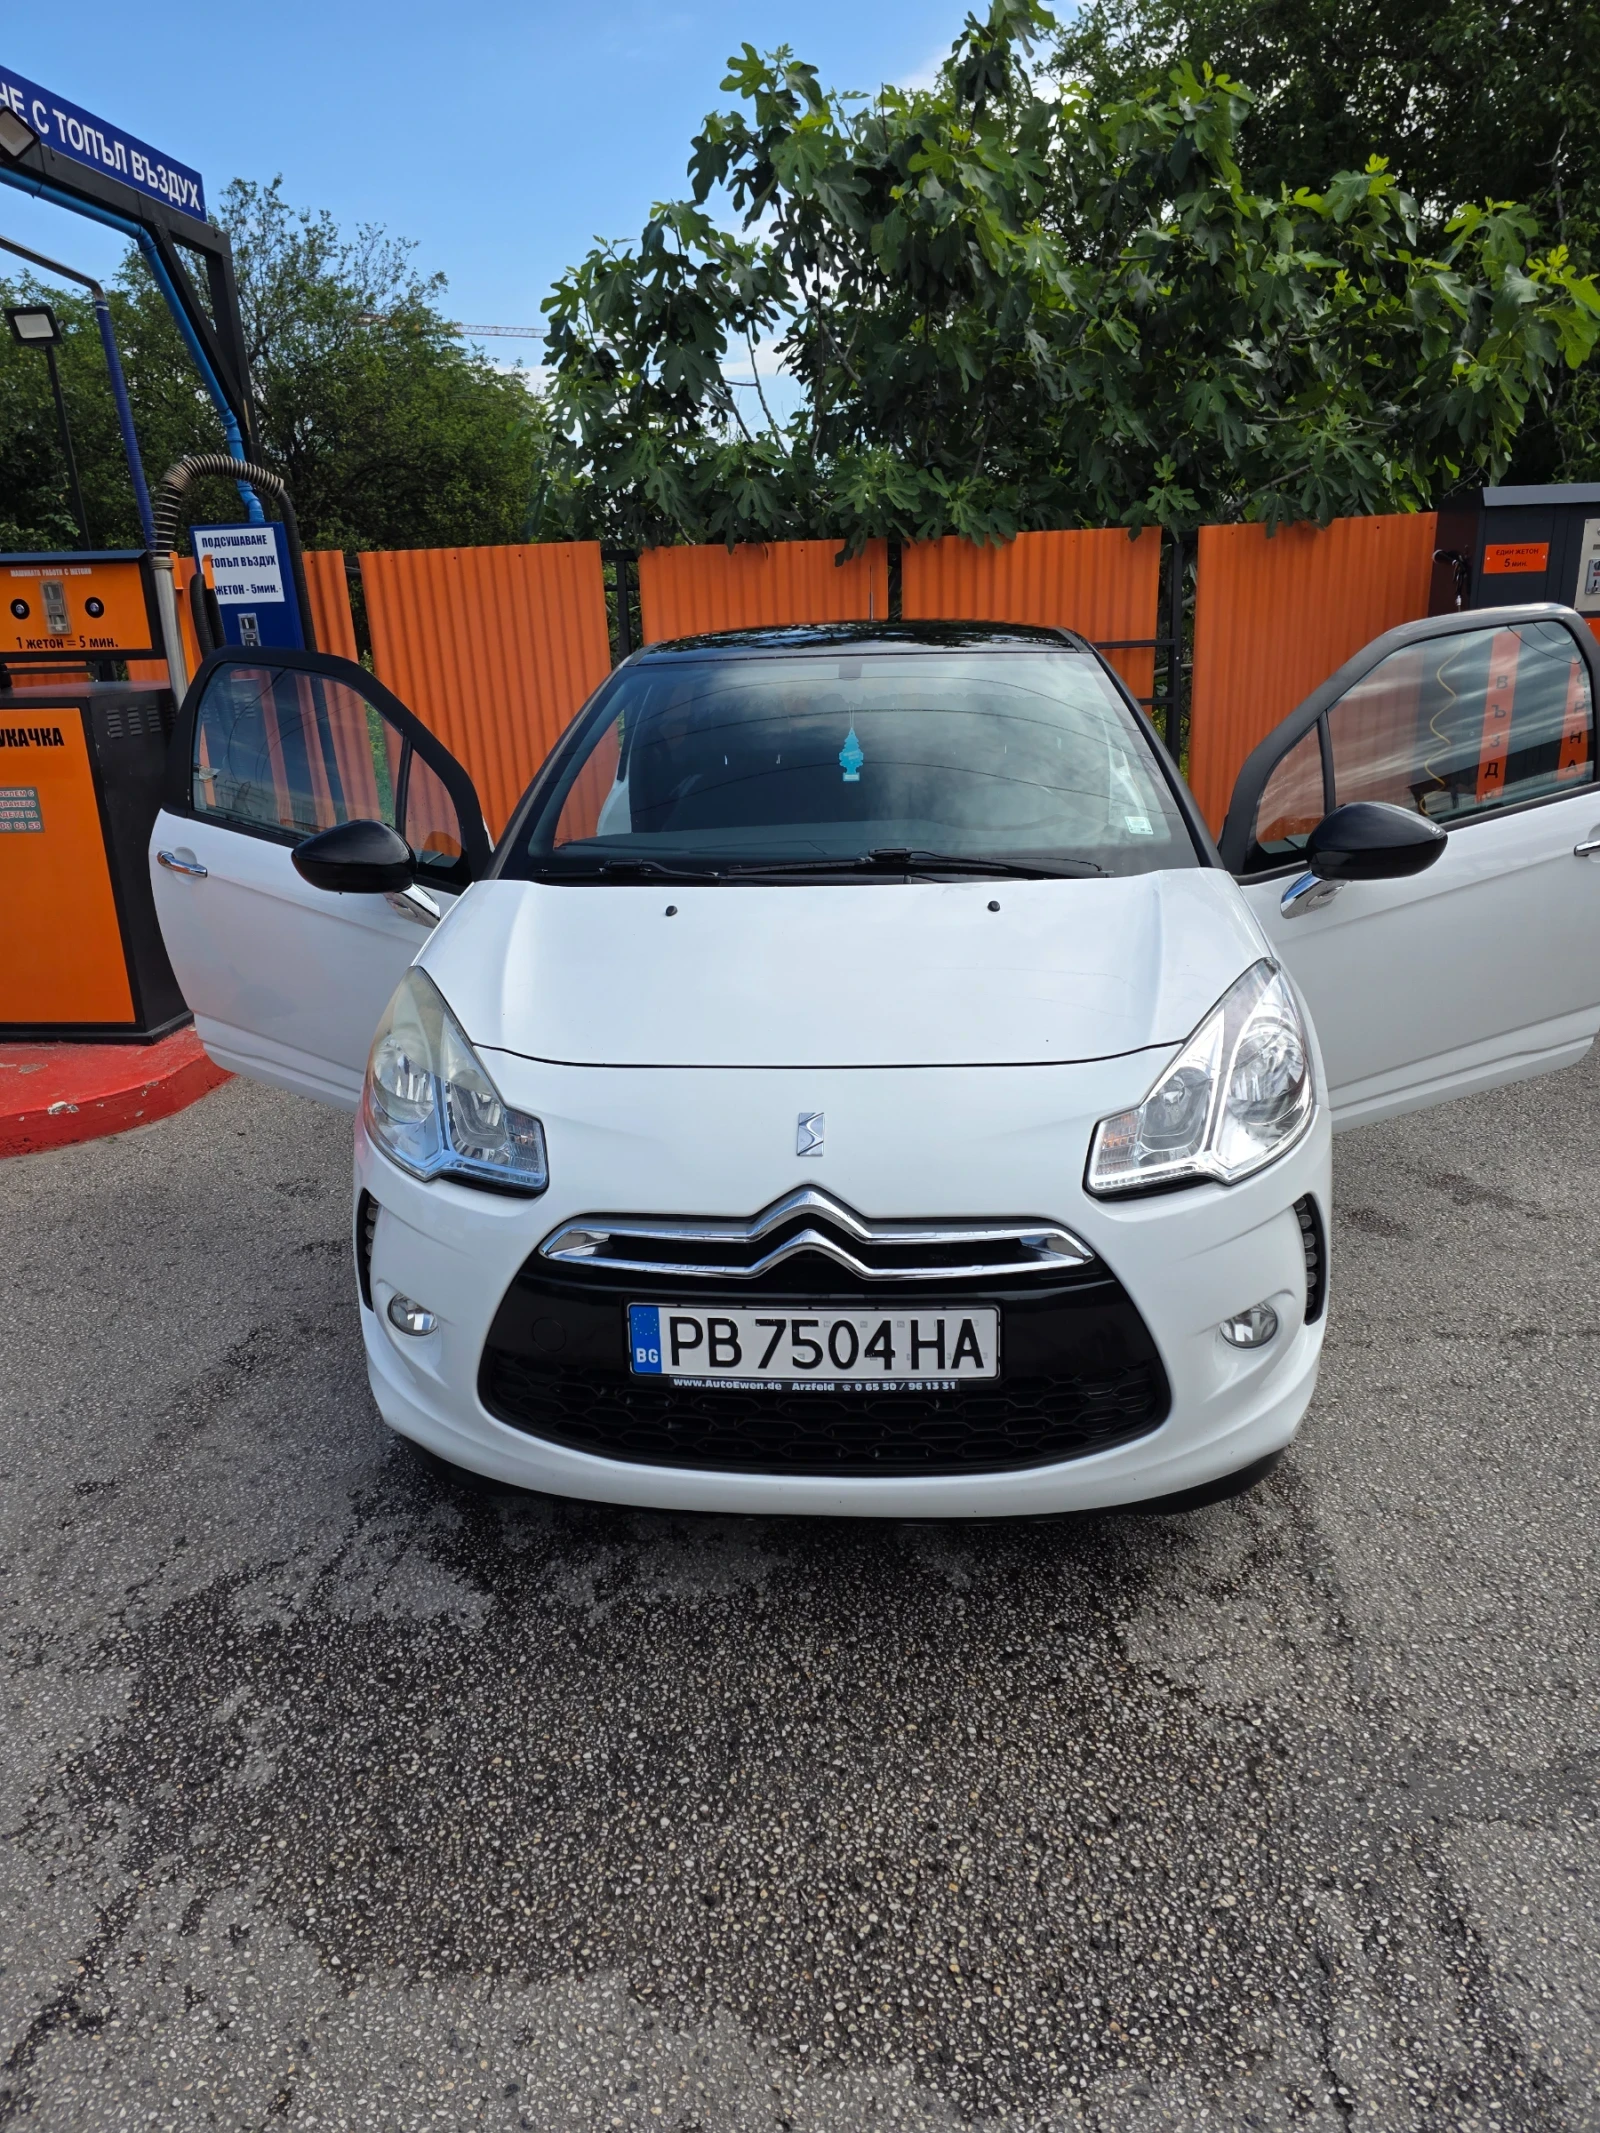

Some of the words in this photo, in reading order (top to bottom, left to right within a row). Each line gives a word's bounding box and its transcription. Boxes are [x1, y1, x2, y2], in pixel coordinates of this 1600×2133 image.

[32, 100, 50, 134] С
[52, 108, 128, 175] ТОПЪЛ
[130, 149, 202, 211] ВЪЗДУХ
[201, 535, 268, 549] ПОДСУШАВАНЕ
[241, 555, 277, 568] ВЪЗДУХ
[1504, 558, 1511, 568] 5
[215, 584, 245, 595] ЖЕТОН
[16, 636, 23, 649] 1
[25, 638, 64, 649] жетон
[79, 635, 86, 648] 5
[89, 638, 119, 648] мин.
[636, 1347, 659, 1364] BG
[792, 1382, 835, 1391] Arzfeld
